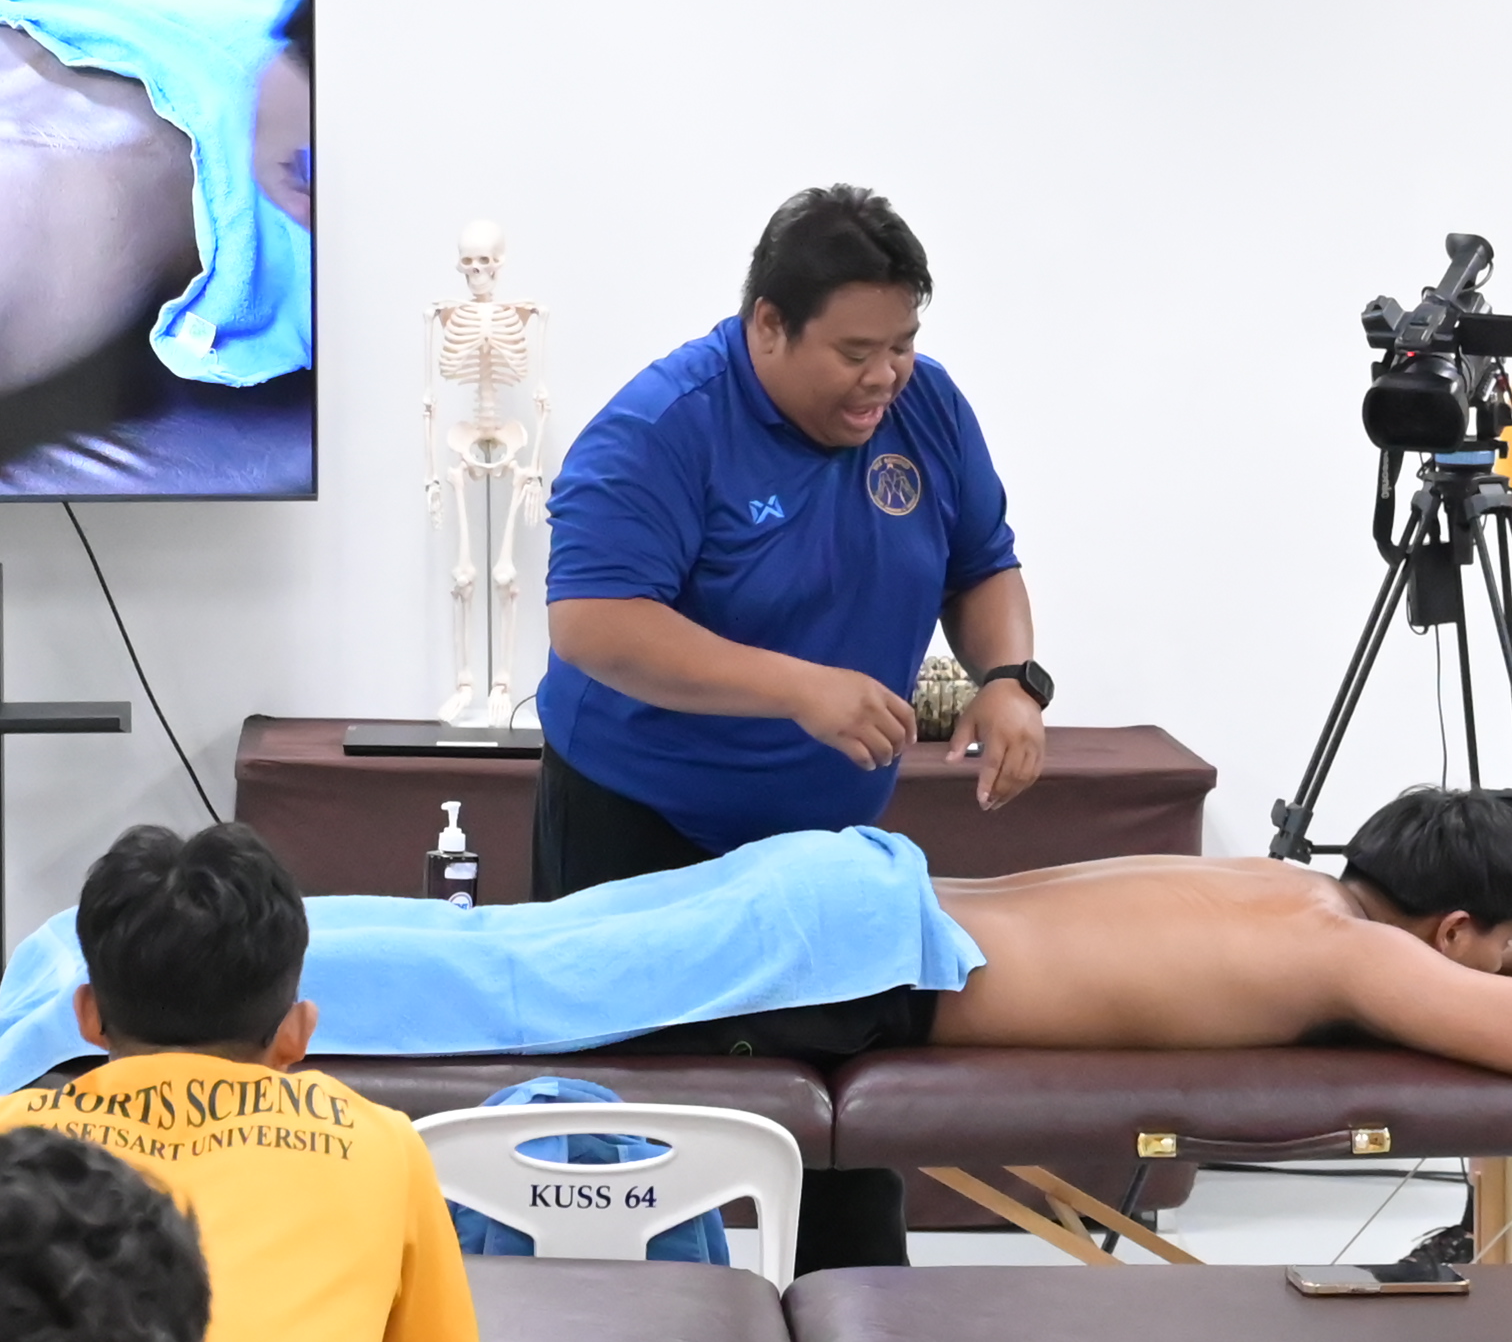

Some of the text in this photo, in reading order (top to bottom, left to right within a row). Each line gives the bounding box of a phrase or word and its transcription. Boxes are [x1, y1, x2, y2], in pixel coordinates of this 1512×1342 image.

[27, 1075, 355, 1130] SPORTS SCIENCE
[41, 1121, 354, 1161] SETSART UNIVERSITY
[529, 1184, 657, 1209] KUSS 64
